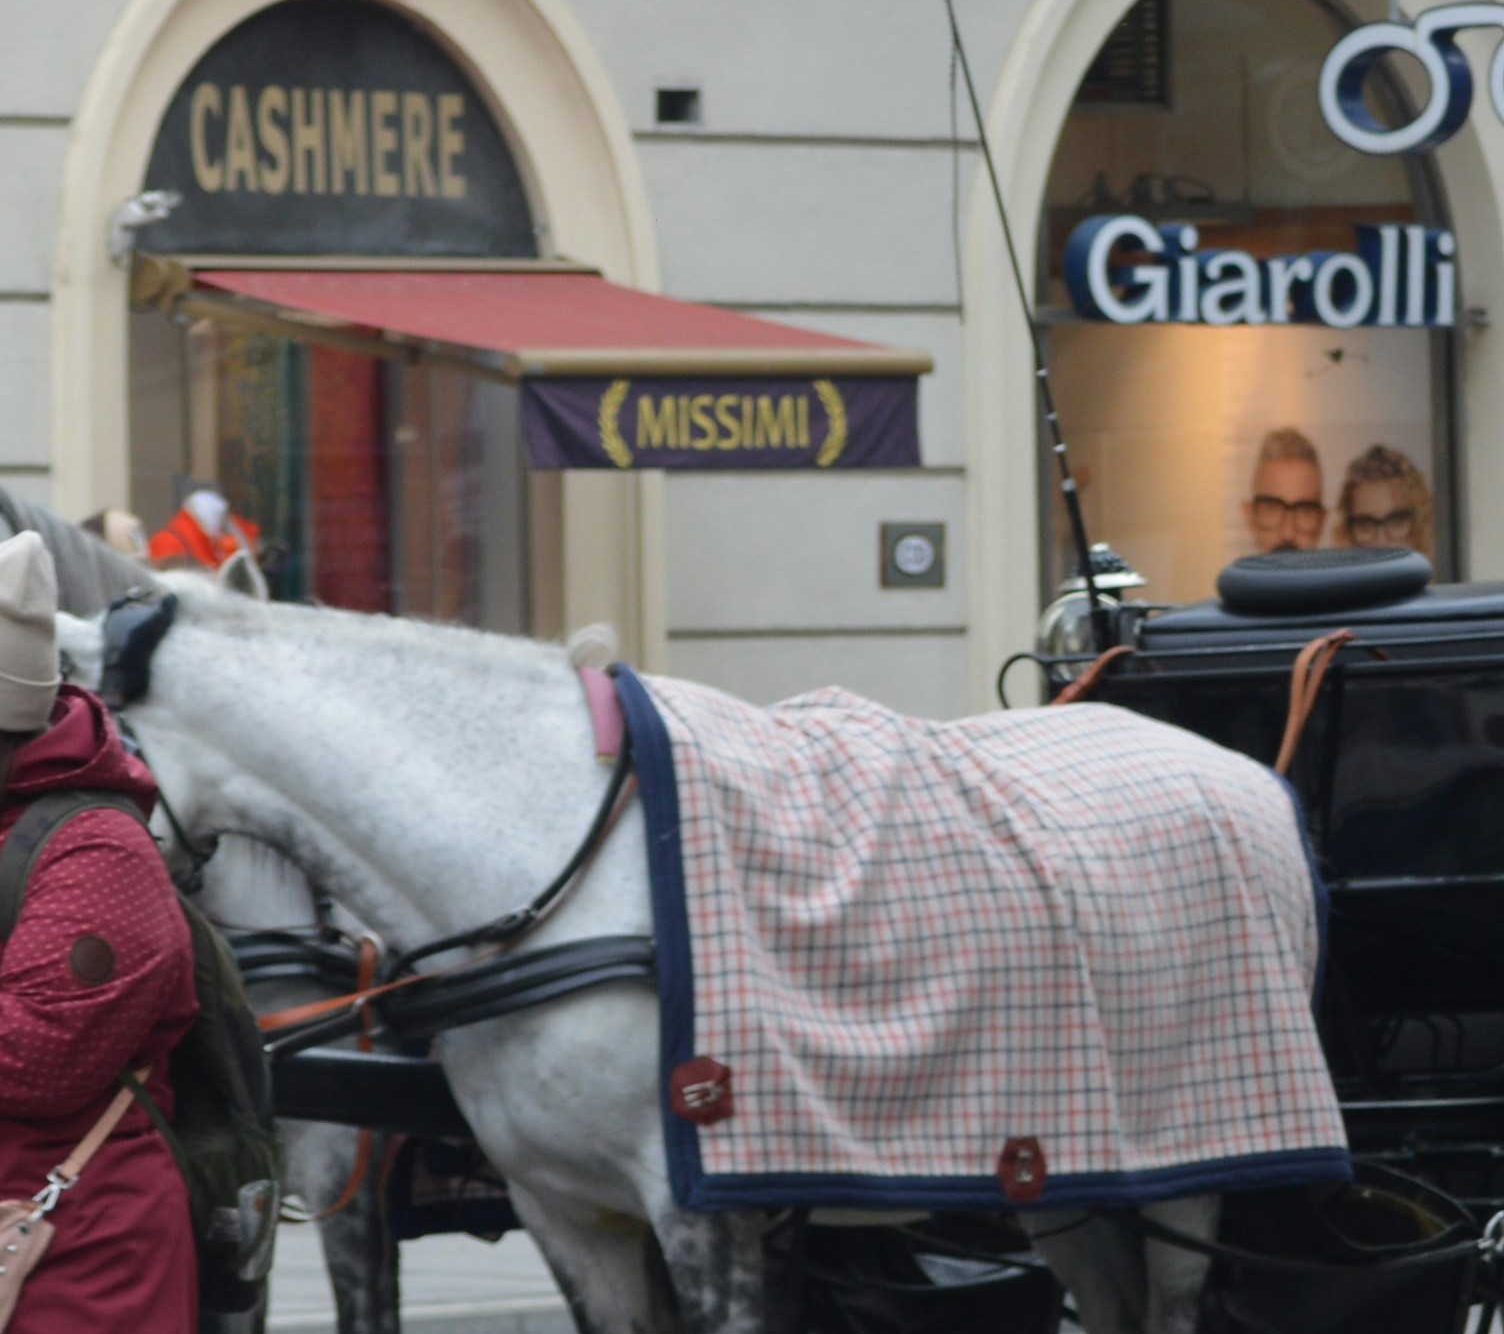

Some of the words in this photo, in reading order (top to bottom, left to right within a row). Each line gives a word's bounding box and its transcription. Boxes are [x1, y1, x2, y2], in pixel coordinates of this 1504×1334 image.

[189, 81, 468, 200] CASHMERE
[1065, 214, 1457, 329] Giarolli
[635, 393, 810, 451] MISSIMI
